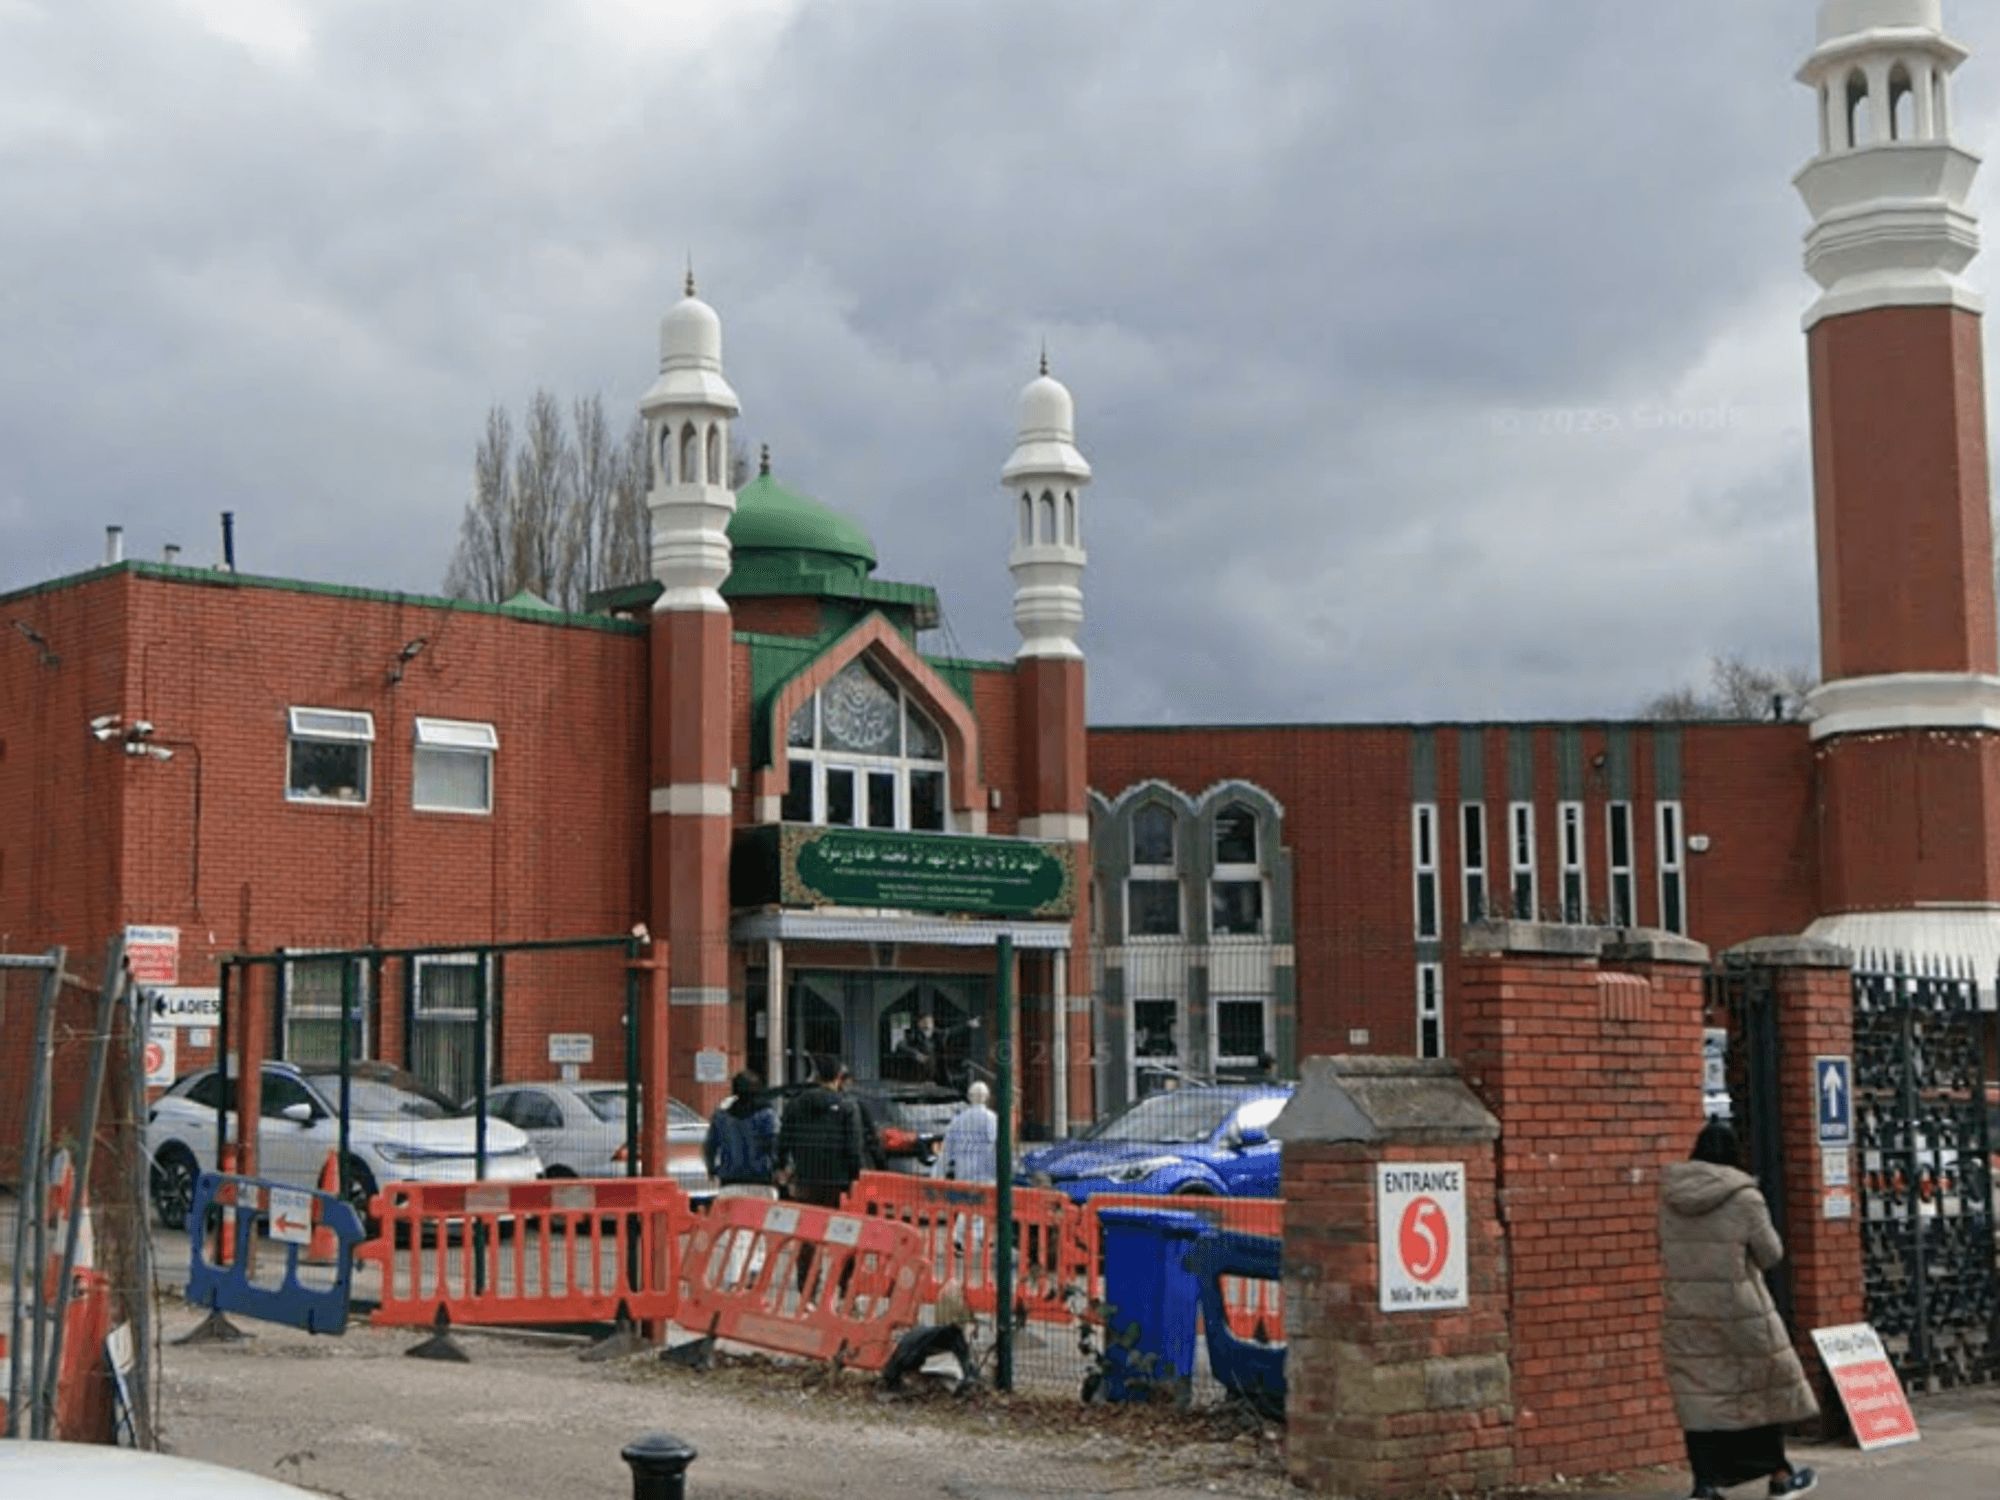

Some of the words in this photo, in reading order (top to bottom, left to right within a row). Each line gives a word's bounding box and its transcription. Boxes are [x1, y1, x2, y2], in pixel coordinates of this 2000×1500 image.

[169, 999, 221, 1015] LADIES
[1384, 1170, 1459, 1193] ENTRANCE
[1411, 1202, 1439, 1276] 5
[1415, 1286, 1432, 1302] Per
